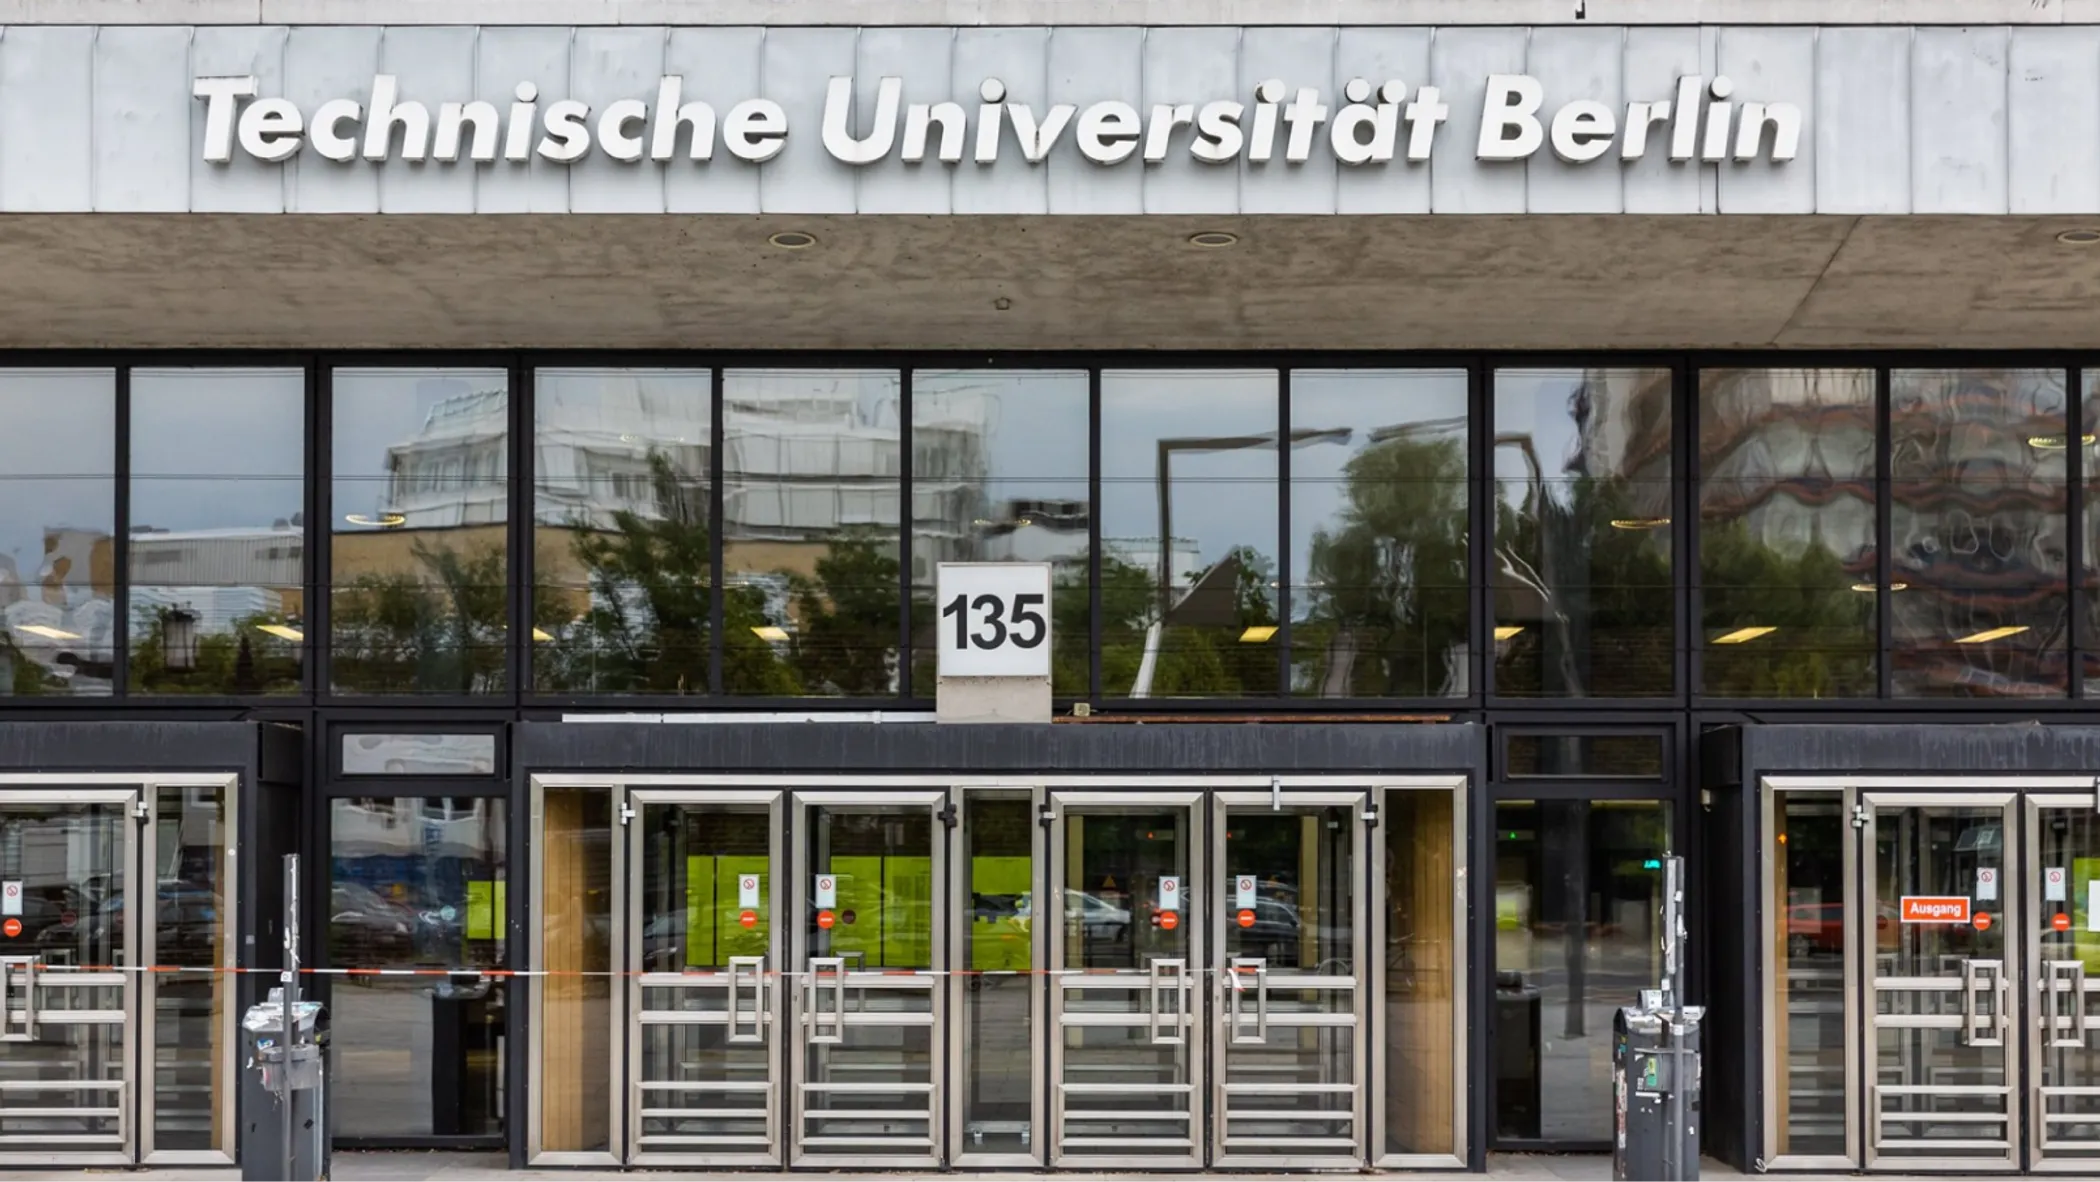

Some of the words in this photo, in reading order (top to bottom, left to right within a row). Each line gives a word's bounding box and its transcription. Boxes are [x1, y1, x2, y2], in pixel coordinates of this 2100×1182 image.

[193, 74, 789, 165] Technische
[820, 75, 1448, 165] Universität
[1474, 74, 1803, 164] Berlin
[942, 593, 1047, 651] 135
[1910, 902, 1962, 917] Ausgang
